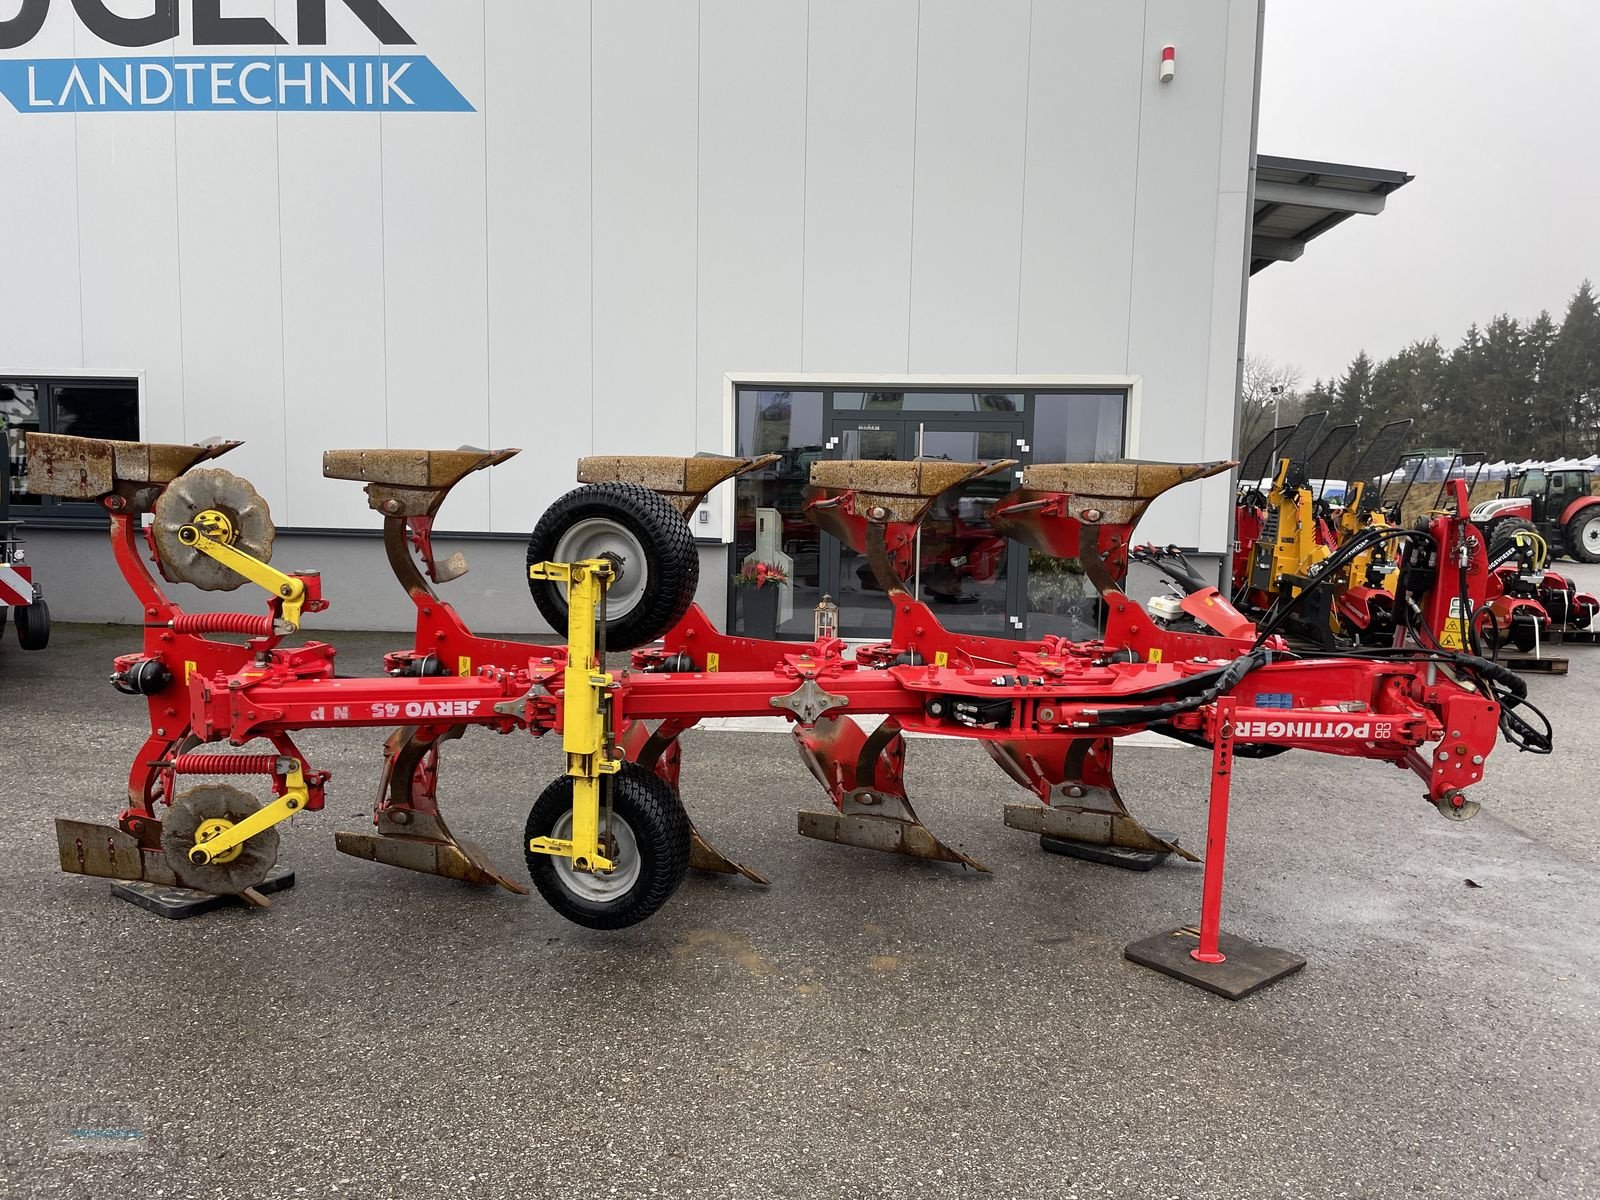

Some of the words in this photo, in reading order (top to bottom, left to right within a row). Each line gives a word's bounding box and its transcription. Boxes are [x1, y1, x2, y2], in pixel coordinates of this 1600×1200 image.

[28, 62, 416, 107] LANDTECHNIK
[310, 706, 324, 721] P
[333, 706, 348, 720] N
[371, 702, 400, 718] 45
[405, 700, 480, 717] SERVO
[1234, 721, 1370, 739] PÖTTINGER
